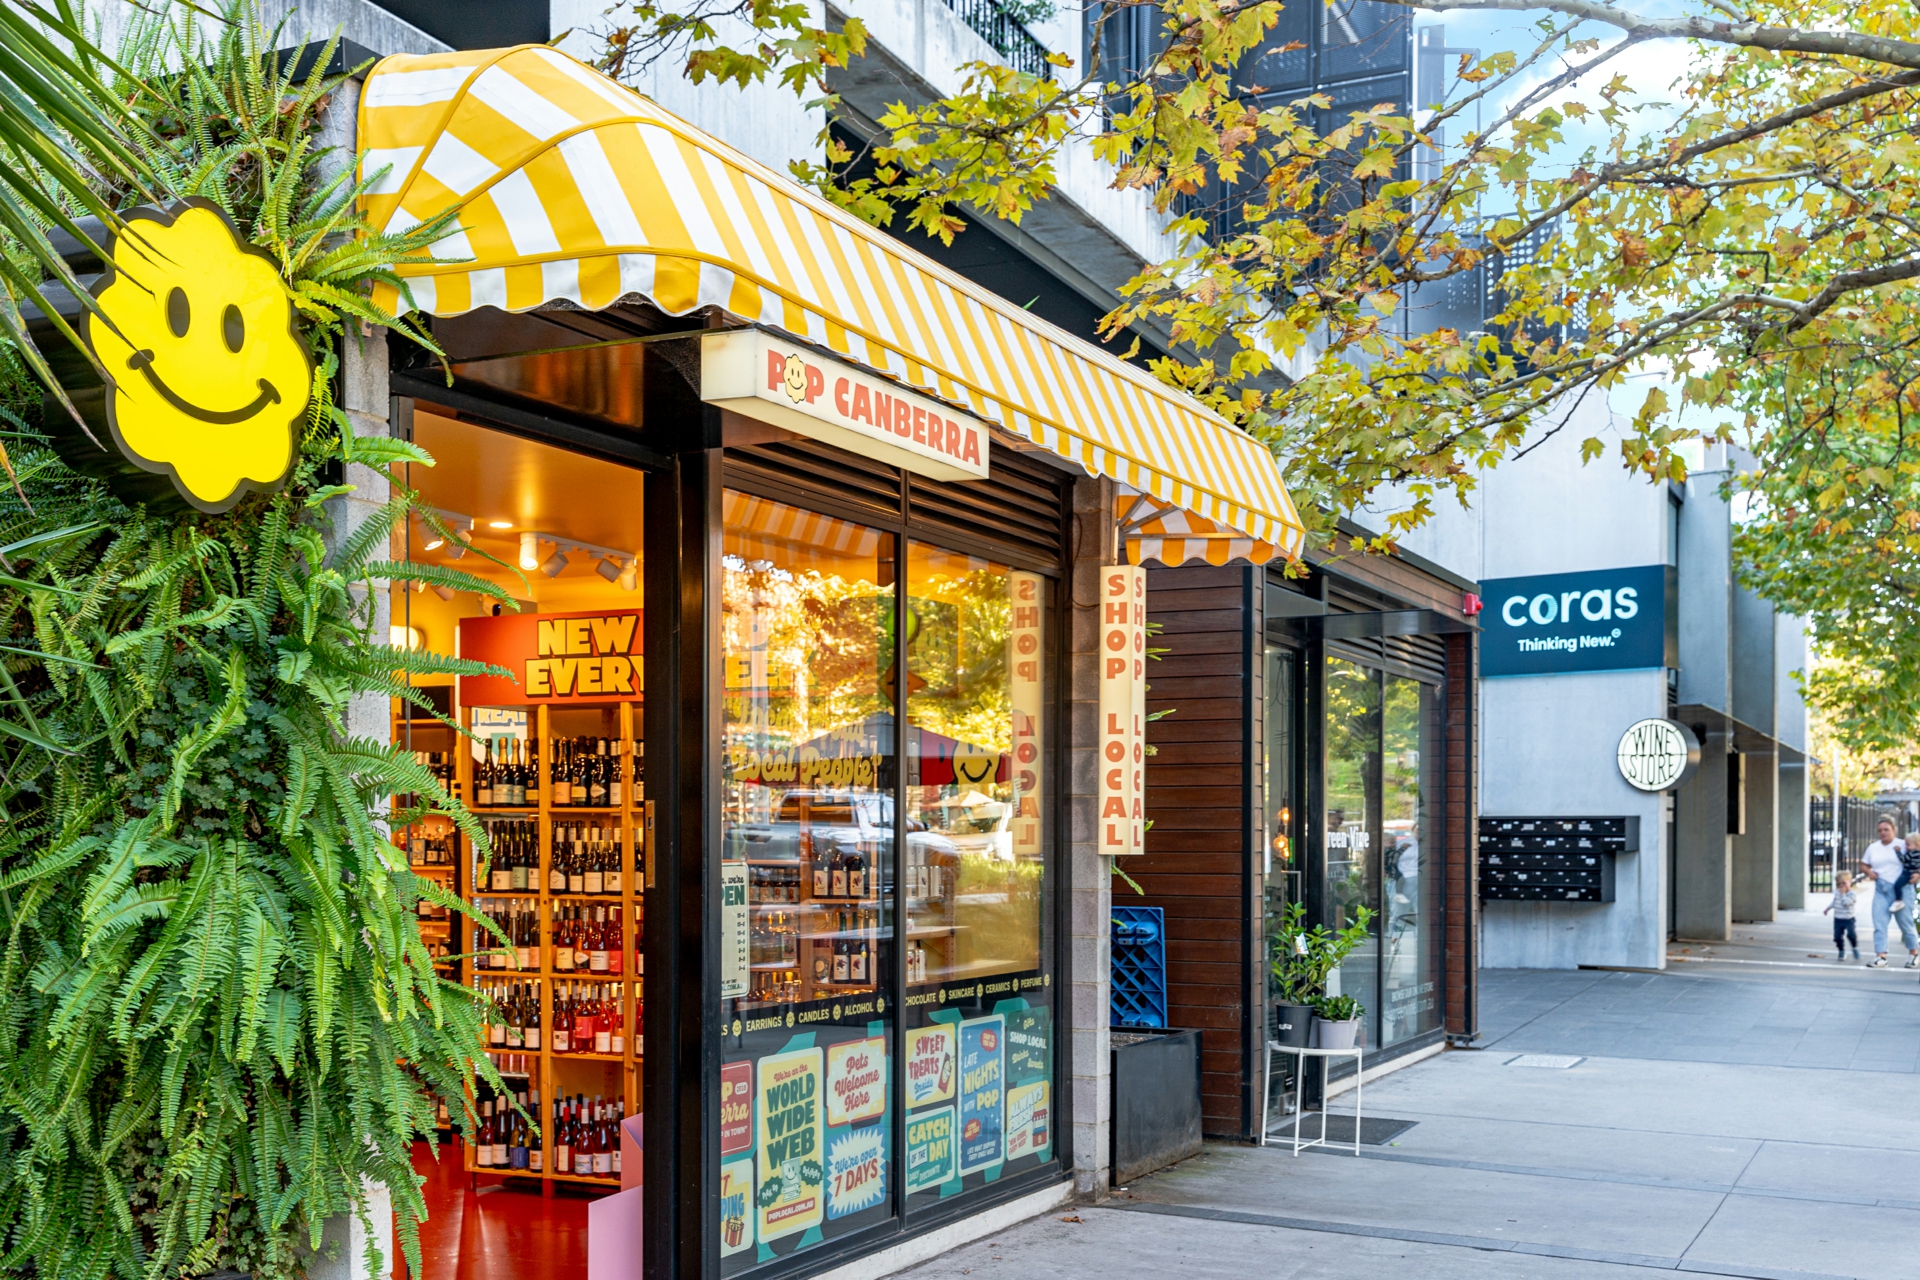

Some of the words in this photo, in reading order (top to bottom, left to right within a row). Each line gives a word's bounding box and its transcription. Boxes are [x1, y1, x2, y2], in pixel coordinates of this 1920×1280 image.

[834, 376, 981, 467] CANBERRA
[1502, 587, 1638, 627] coras
[538, 615, 640, 658] NEW
[1105, 574, 1127, 680] SHOP
[1133, 576, 1143, 681] SHOP
[1518, 636, 1577, 652] Thinking
[1633, 724, 1671, 755] WINE
[730, 742, 796, 782] Local
[1629, 754, 1674, 785] STORE
[1102, 713, 1127, 846] LOCAL
[1132, 714, 1142, 847] LOCAL
[746, 1016, 782, 1032] EARRINGS
[798, 1009, 830, 1023] CANDLES
[844, 1002, 874, 1016] ALCOHOL
[948, 986, 975, 1000] SKINCARE
[986, 982, 1010, 994] CERAMICS
[1020, 976, 1042, 988] PERFUME
[916, 1035, 945, 1057] SWEET
[1010, 1031, 1027, 1044] SHOP
[1027, 1035, 1047, 1049] LOCAL
[799, 1064, 808, 1073] the
[846, 1053, 868, 1074] Pets
[909, 1056, 939, 1080] TREATS
[964, 1051, 978, 1069] LATE
[835, 1069, 880, 1097] Welcome
[914, 1078, 934, 1094] Inside
[964, 1058, 999, 1096] NIGHTS
[767, 1072, 815, 1113] WORLD
[844, 1091, 870, 1112] Here
[976, 1089, 999, 1111] POP
[1009, 1085, 1044, 1120] ALWAYS
[767, 1100, 815, 1140] WIDE
[909, 1116, 949, 1145] CATCH
[767, 1126, 815, 1170] WEB
[835, 1156, 858, 1174] We're
[860, 1146, 878, 1163] open
[910, 1153, 917, 1164] OF
[917, 1148, 926, 1160] THE
[929, 1138, 949, 1162] DAY
[834, 1174, 842, 1198] 7
[845, 1158, 878, 1192] DAYS
[909, 1170, 920, 1182] DAILY
[768, 1200, 814, 1221] POPLOCAL.COM.AU
